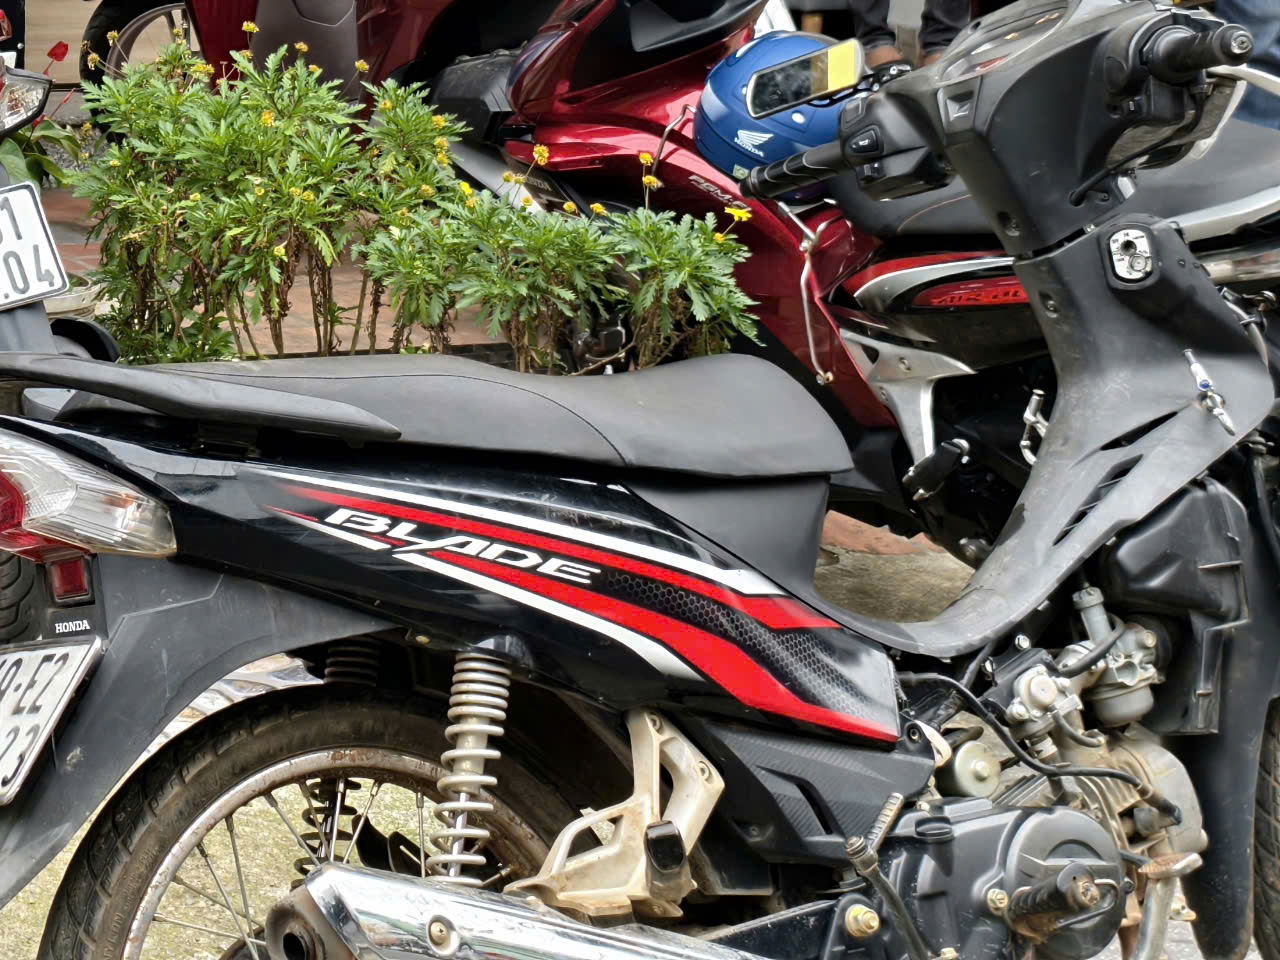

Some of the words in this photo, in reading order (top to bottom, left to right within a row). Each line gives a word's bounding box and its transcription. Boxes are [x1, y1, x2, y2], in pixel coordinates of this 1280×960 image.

[734, 137, 765, 158] HONDA
[323, 507, 602, 585] BLADE
[55, 619, 91, 634] HONDA
